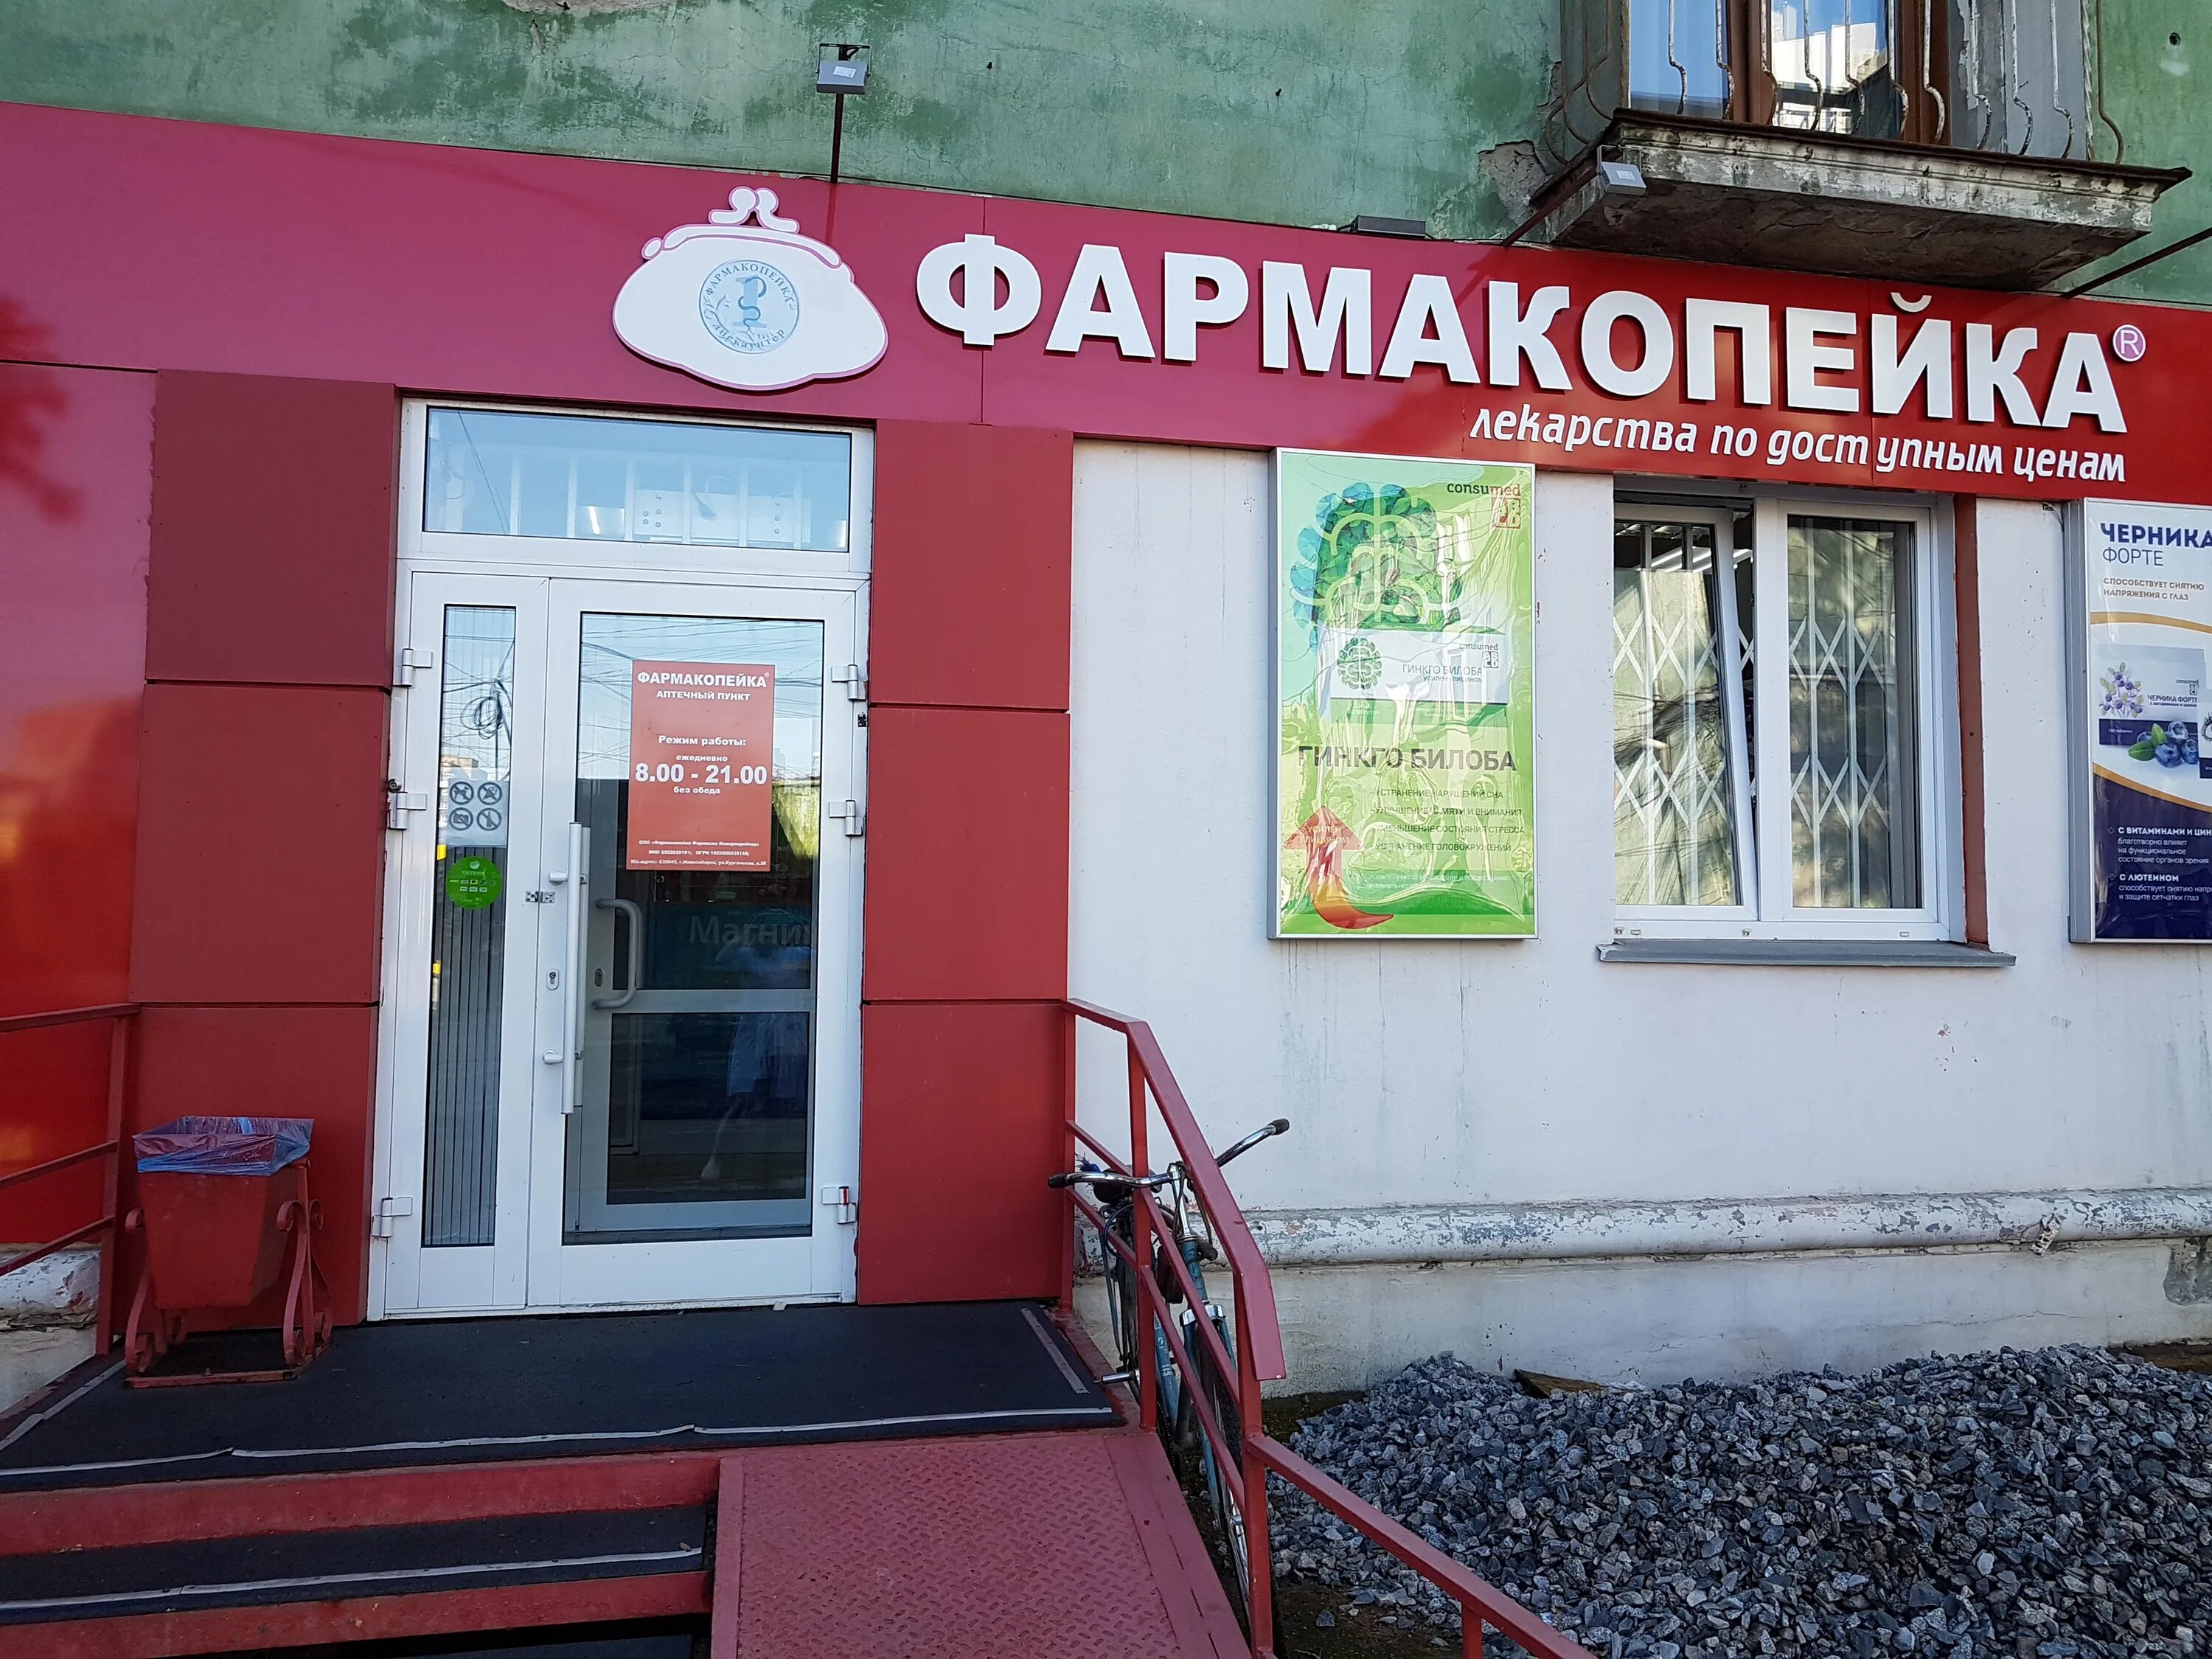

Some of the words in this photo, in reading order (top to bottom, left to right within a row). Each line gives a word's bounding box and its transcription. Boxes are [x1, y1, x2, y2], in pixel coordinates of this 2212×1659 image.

[706, 262, 795, 303] ФАРМАКОПЕЙКА
[917, 234, 2128, 433] ФАРМАКОПЕЙКА
[1470, 404, 1696, 453] лекарства
[1710, 425, 1757, 456] по
[2011, 445, 2126, 482] ценам
[1447, 484, 1521, 496] consumed
[2100, 523, 2212, 548] ЧЕРНИКА
[2102, 546, 2164, 566] ФОРТЕ
[2104, 578, 2167, 588] СПОСОБСТВУЕТ
[2169, 582, 2205, 591] СНЯТИЮ
[2104, 589, 2160, 599] НАПРЯЖЕНИЯ
[2170, 593, 2189, 601] ГЛАЗ
[1402, 664, 1441, 674] ГИНКГО
[637, 672, 767, 688] ФАРМАКОПЕЙКА
[656, 690, 714, 700] АПТЕЧНЫЙ
[717, 692, 751, 700] ПУНКТ
[658, 735, 698, 746] Режим
[701, 737, 747, 747] работы:
[676, 754, 728, 762] ежедневно
[1299, 745, 1403, 768] ГИНКГО
[1411, 748, 1517, 771] БИЛОБА
[635, 762, 684, 782] 8.00
[705, 765, 768, 785] 21.00
[674, 786, 691, 794] без
[693, 787, 720, 795] обеда
[2126, 827, 2185, 835] ВИТАМИНАМИ
[2194, 829, 2212, 837] ЦИН
[2118, 838, 2163, 846] благотворно
